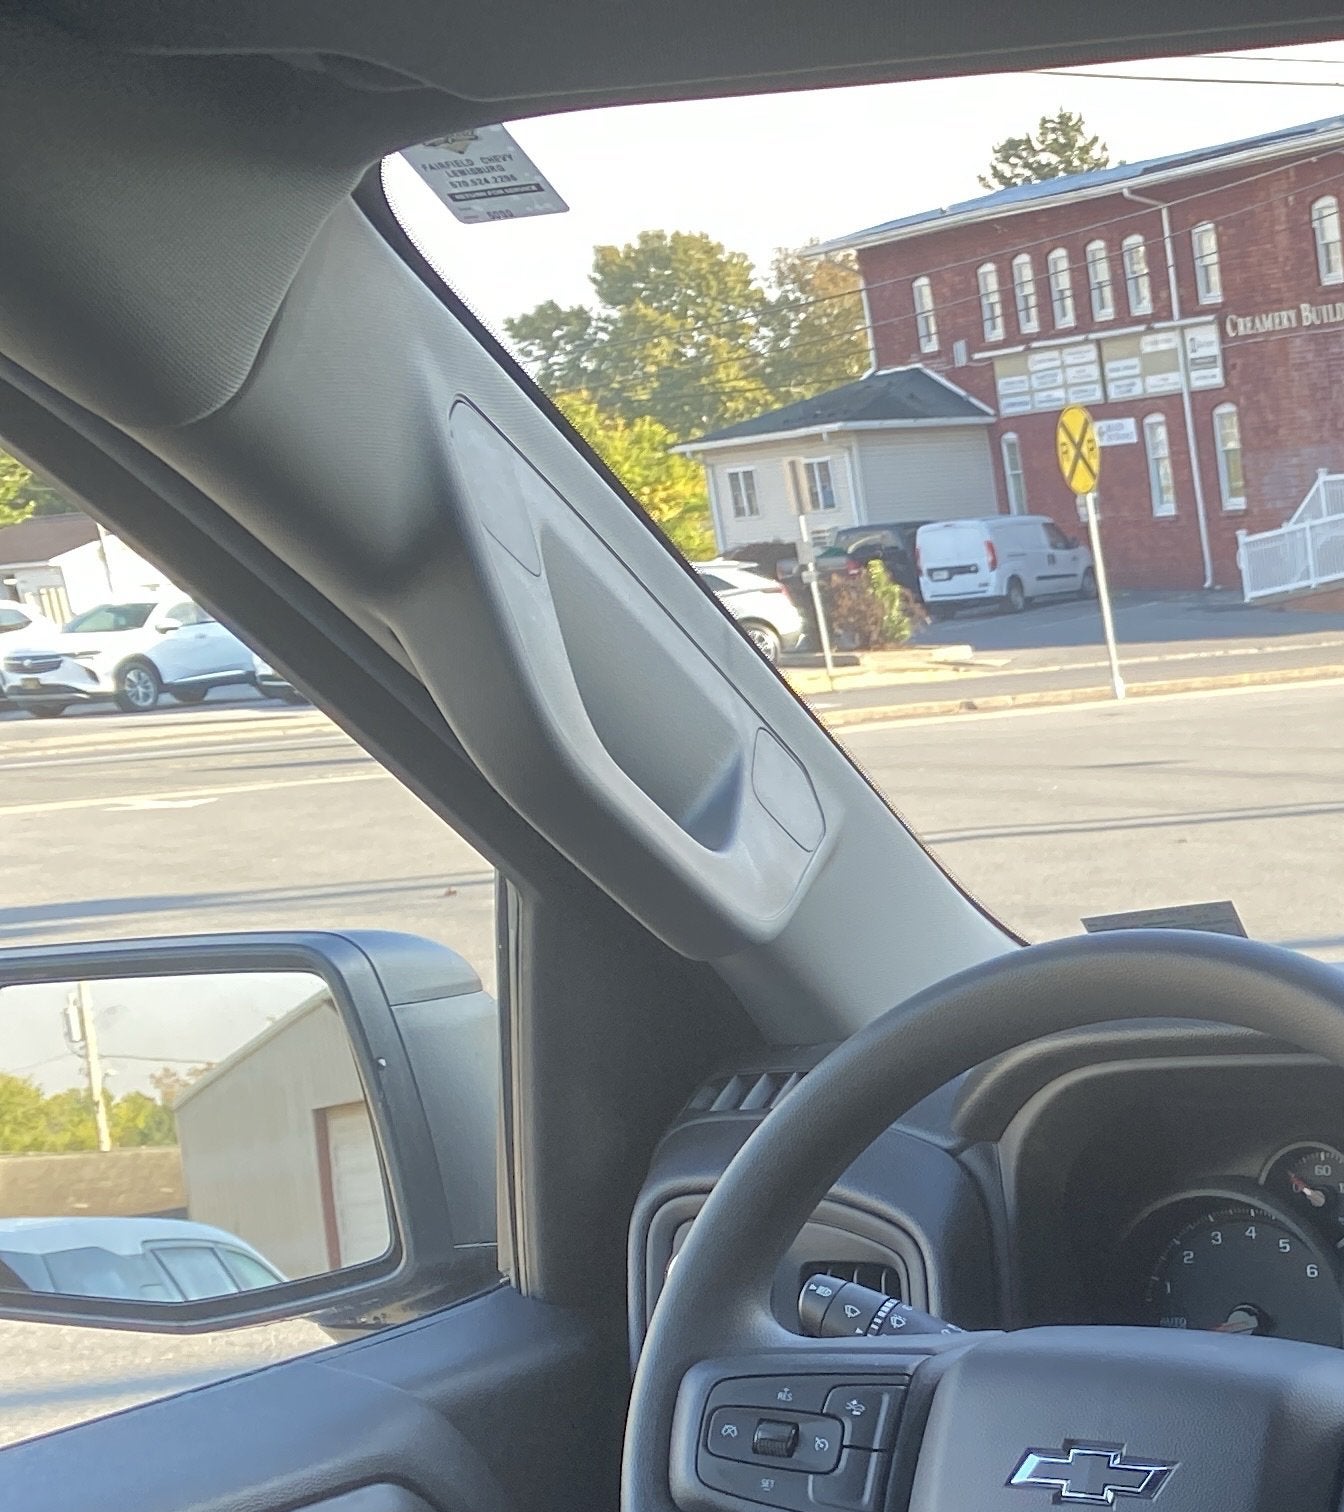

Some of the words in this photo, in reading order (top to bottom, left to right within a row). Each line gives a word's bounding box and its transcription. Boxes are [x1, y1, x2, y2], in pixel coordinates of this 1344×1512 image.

[421, 159, 475, 172] FAIRFIELD
[480, 154, 514, 164] CHEVY
[444, 166, 506, 178] LEWISBURG
[1314, 1165, 1331, 1177] 60
[1211, 1231, 1222, 1245] 3
[1245, 1226, 1257, 1239] 4
[1279, 1239, 1290, 1252] 5
[1183, 1251, 1194, 1264] 2
[1306, 1264, 1318, 1278] 6
